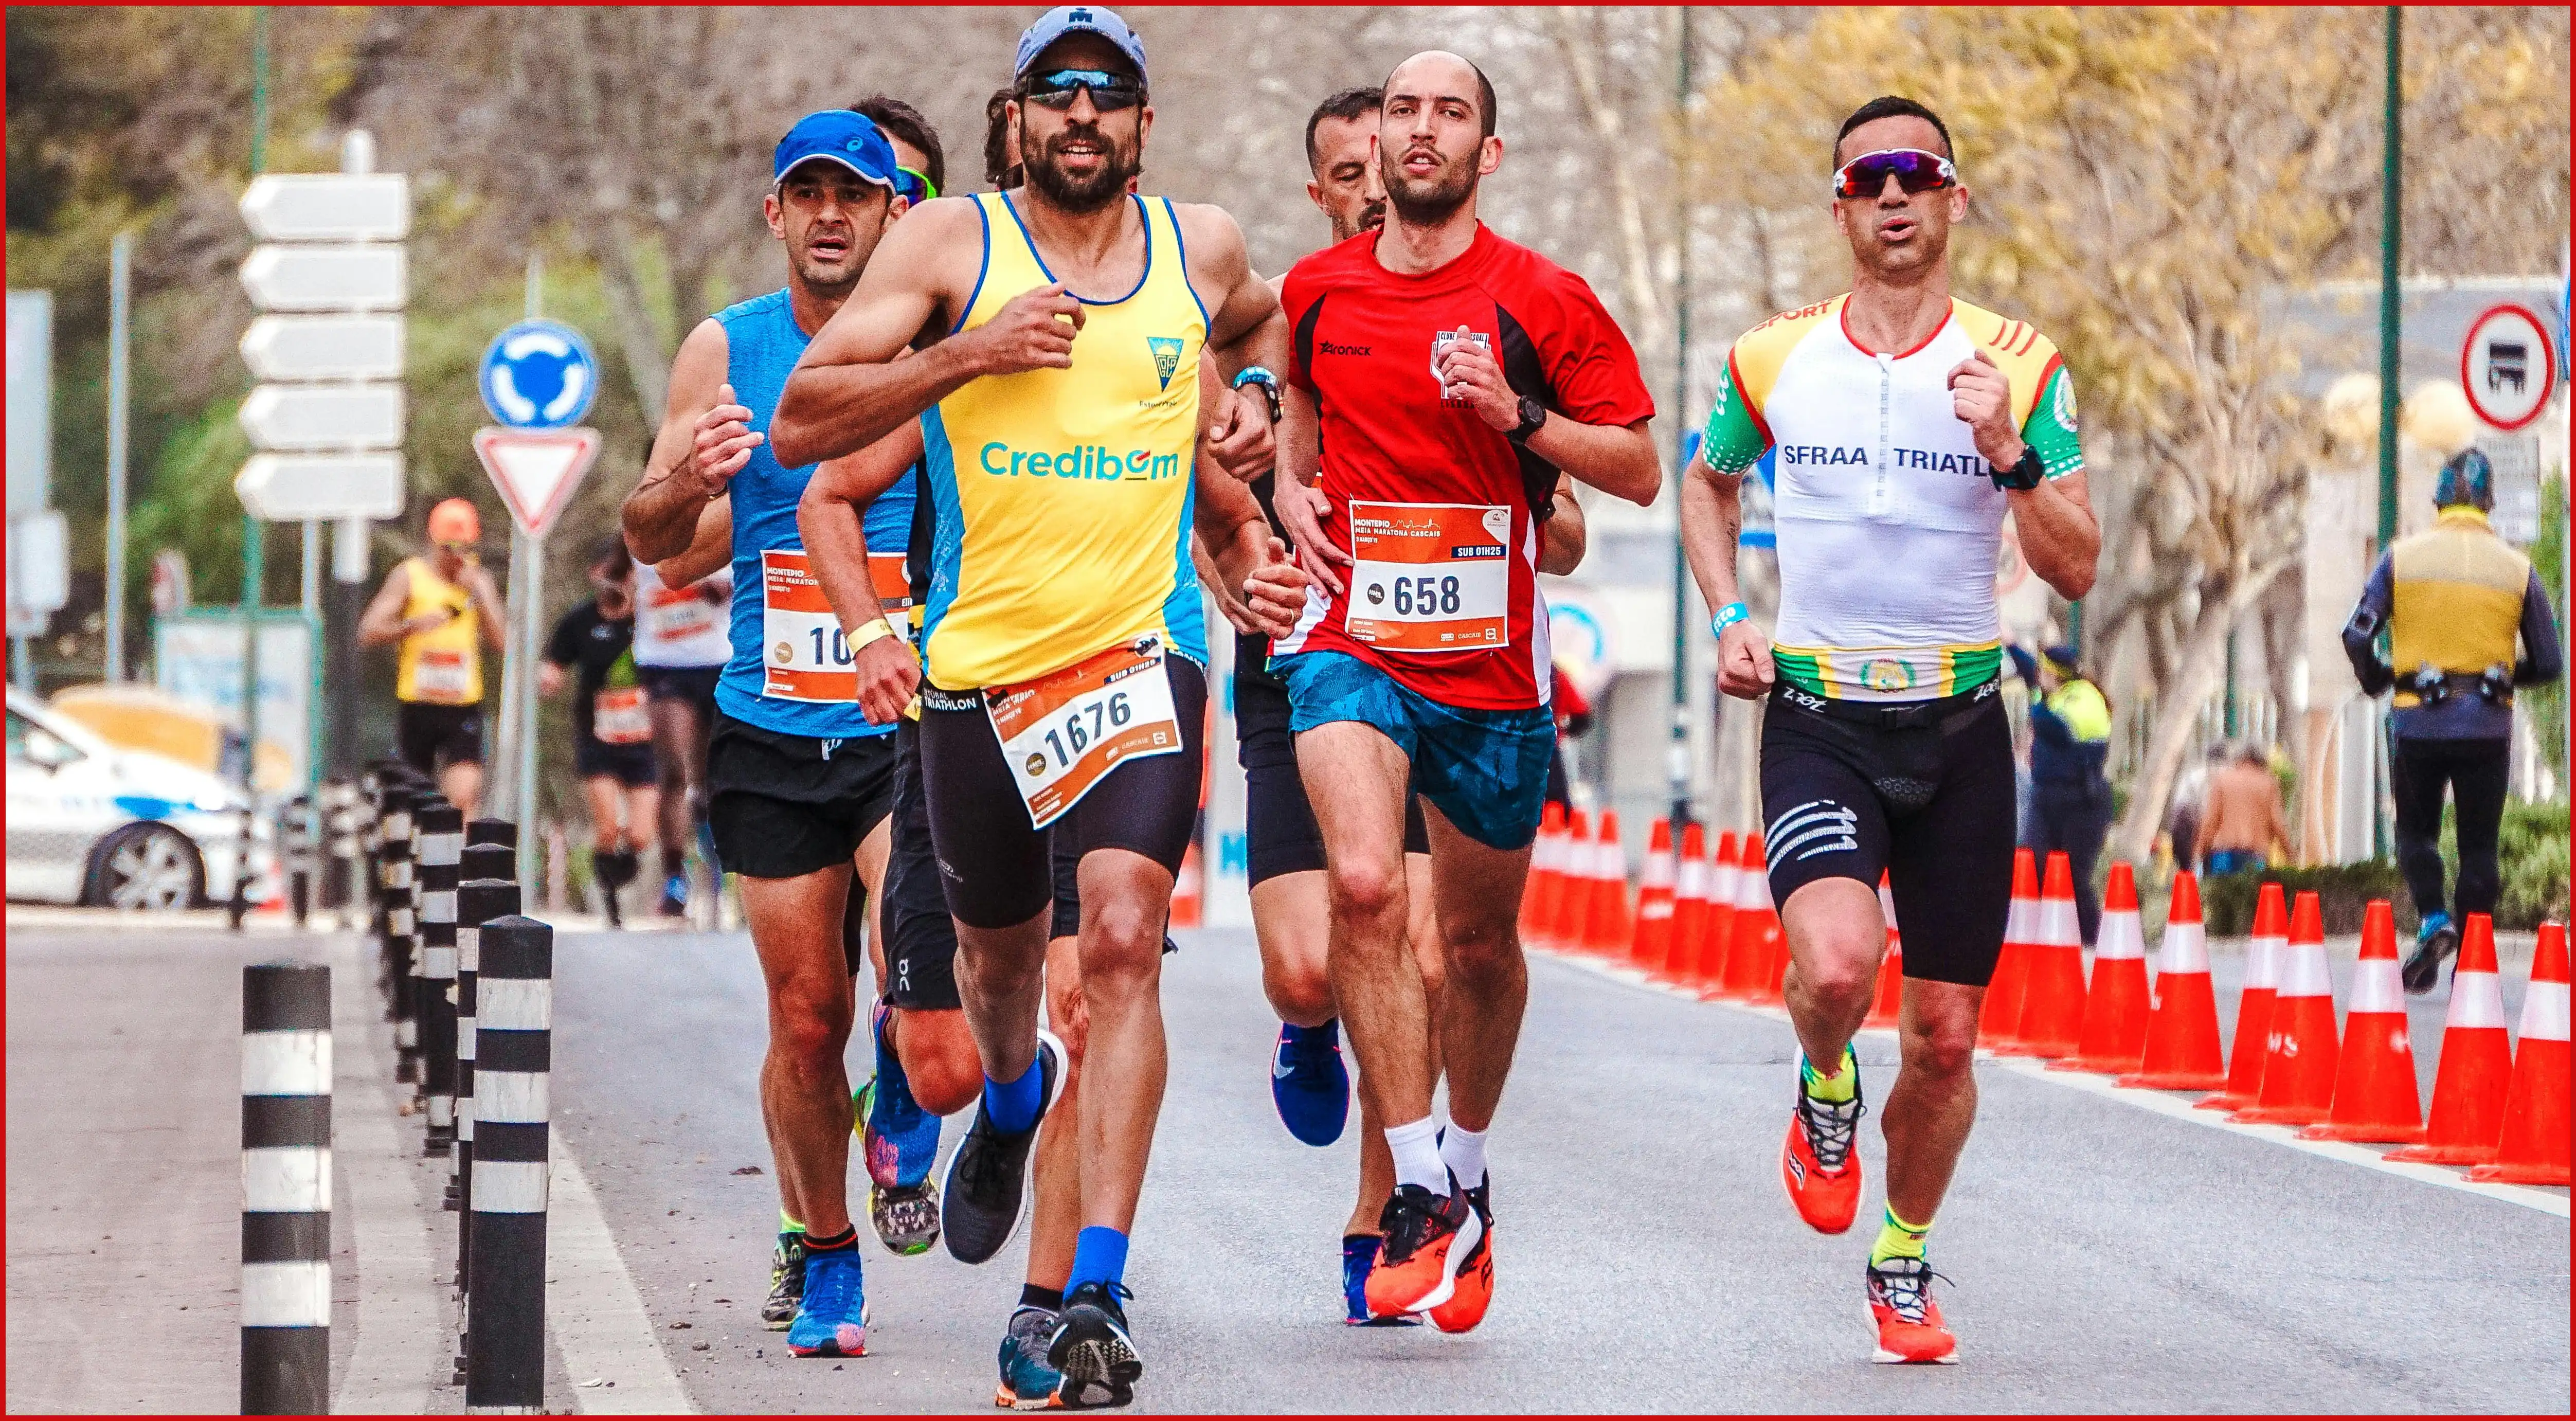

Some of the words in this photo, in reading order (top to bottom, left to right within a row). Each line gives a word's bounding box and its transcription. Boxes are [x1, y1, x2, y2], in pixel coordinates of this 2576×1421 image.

[1440, 332, 1455, 340] CLUBE
[980, 441, 1179, 481] Credibom
[1785, 445, 1868, 465] SFRAA
[1894, 447, 1988, 477] TRIATL
[1374, 528, 1408, 536] MARATONA
[1457, 547, 1474, 556] SUB
[1476, 546, 1501, 556] 01H25
[786, 577, 819, 586] MARATON
[1394, 575, 1461, 616] 658
[1110, 669, 1127, 682] SUB
[924, 696, 977, 710] TRIATHLON
[993, 703, 1011, 716] MEIA
[1044, 692, 1130, 768] 1676
